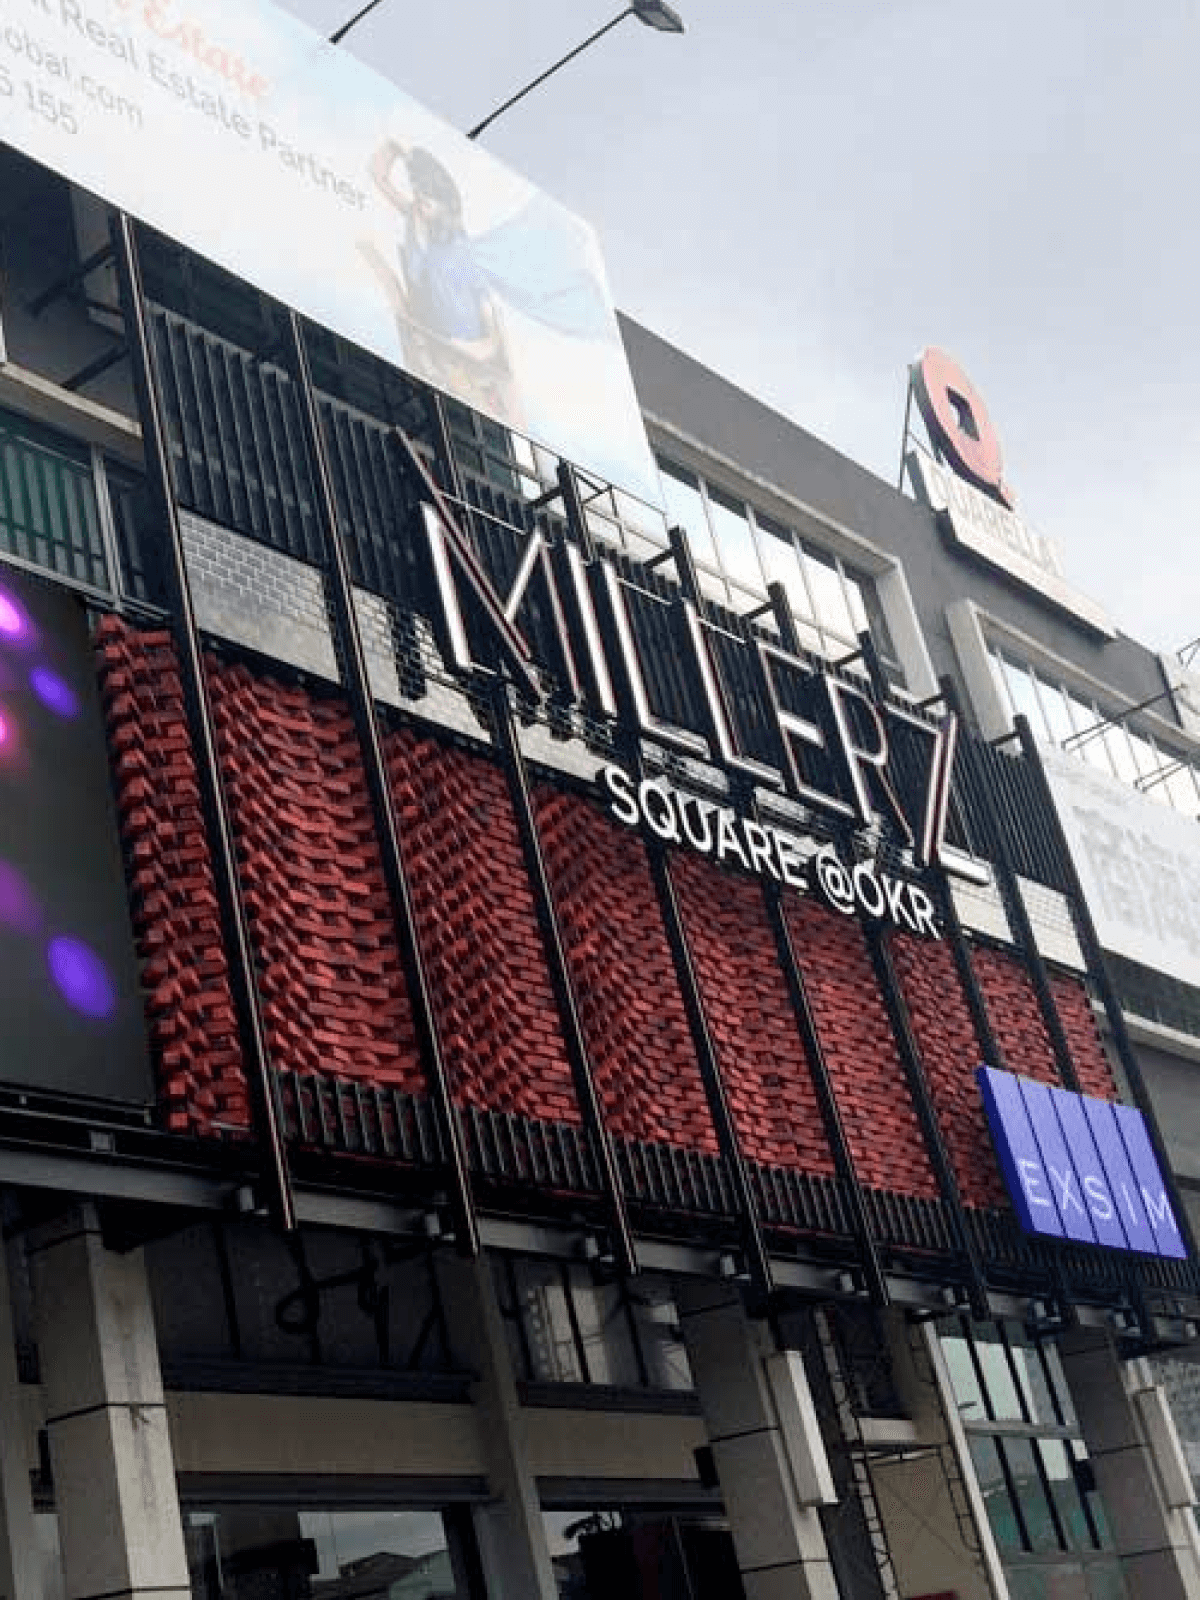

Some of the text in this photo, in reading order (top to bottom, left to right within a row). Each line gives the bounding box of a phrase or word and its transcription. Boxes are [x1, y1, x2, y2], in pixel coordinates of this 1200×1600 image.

[23, 80, 79, 135] 155
[59, 0, 372, 211] Real Estate Partner
[400, 430, 991, 888] MILLERZ
[604, 764, 810, 891] SQUARE
[815, 851, 943, 941] @OKR
[1018, 1158, 1178, 1234] EXSIM
